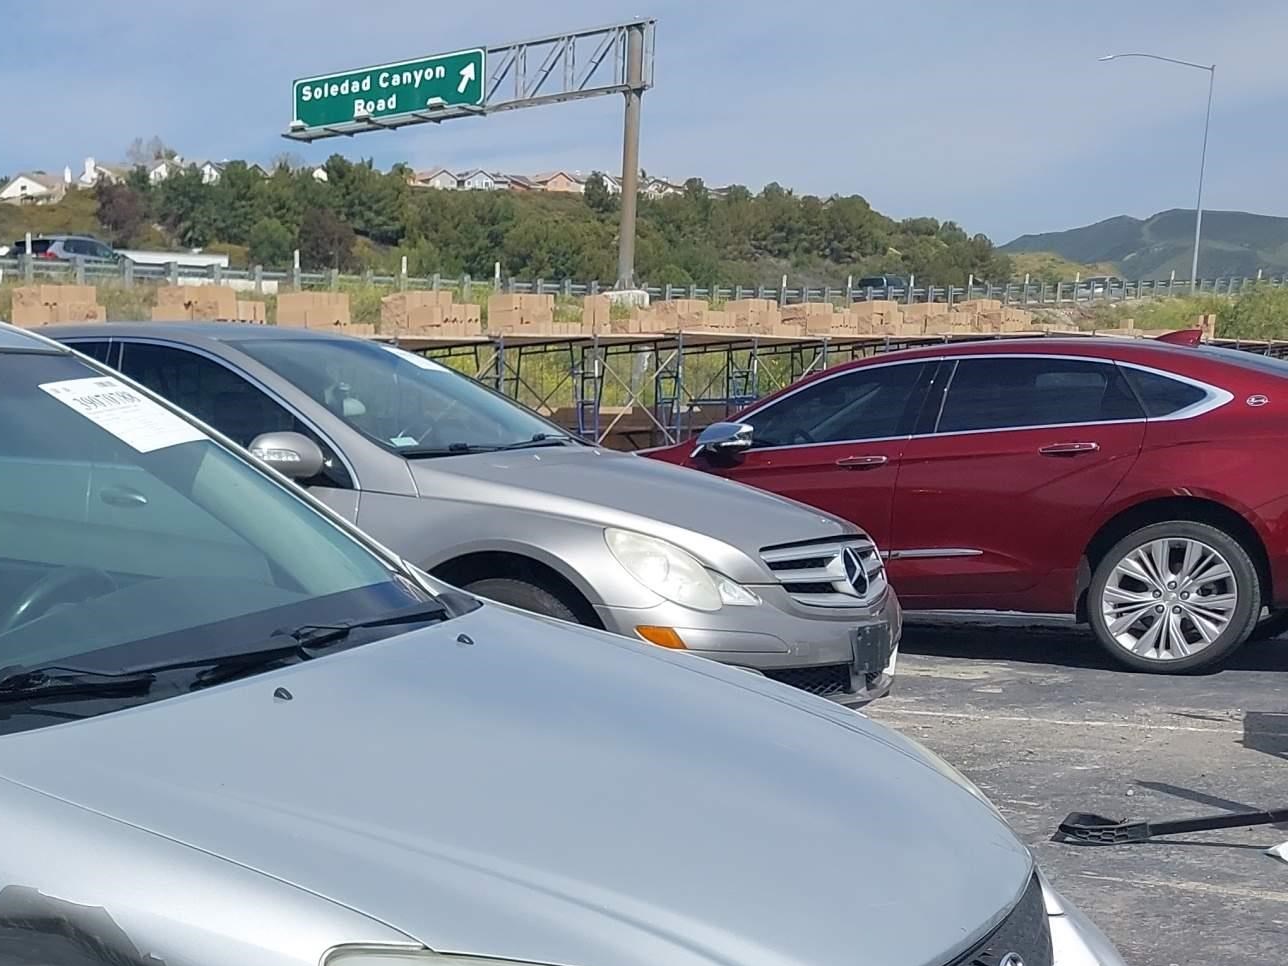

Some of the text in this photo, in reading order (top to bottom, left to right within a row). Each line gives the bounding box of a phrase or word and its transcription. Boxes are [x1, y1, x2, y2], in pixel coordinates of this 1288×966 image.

[302, 65, 445, 101] Soledad Canyon
[354, 93, 397, 114] Road
